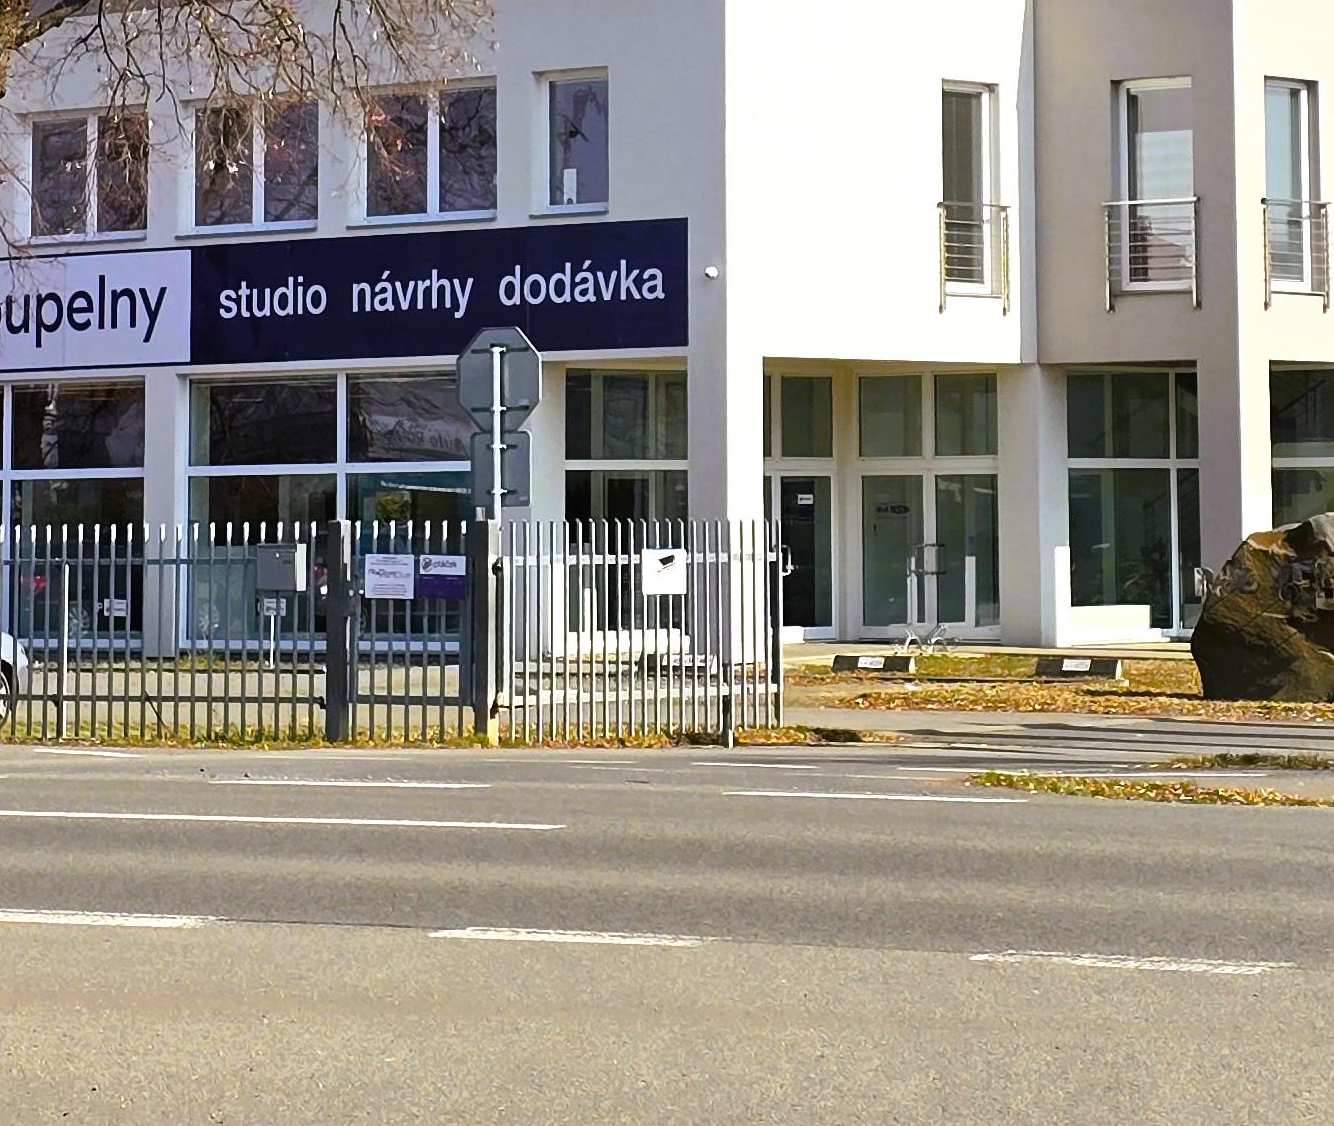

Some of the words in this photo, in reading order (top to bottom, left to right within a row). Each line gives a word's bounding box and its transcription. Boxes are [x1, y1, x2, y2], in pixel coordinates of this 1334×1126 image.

[218, 276, 327, 319] studio
[352, 269, 474, 319] návrhy
[498, 259, 665, 306] dodávka
